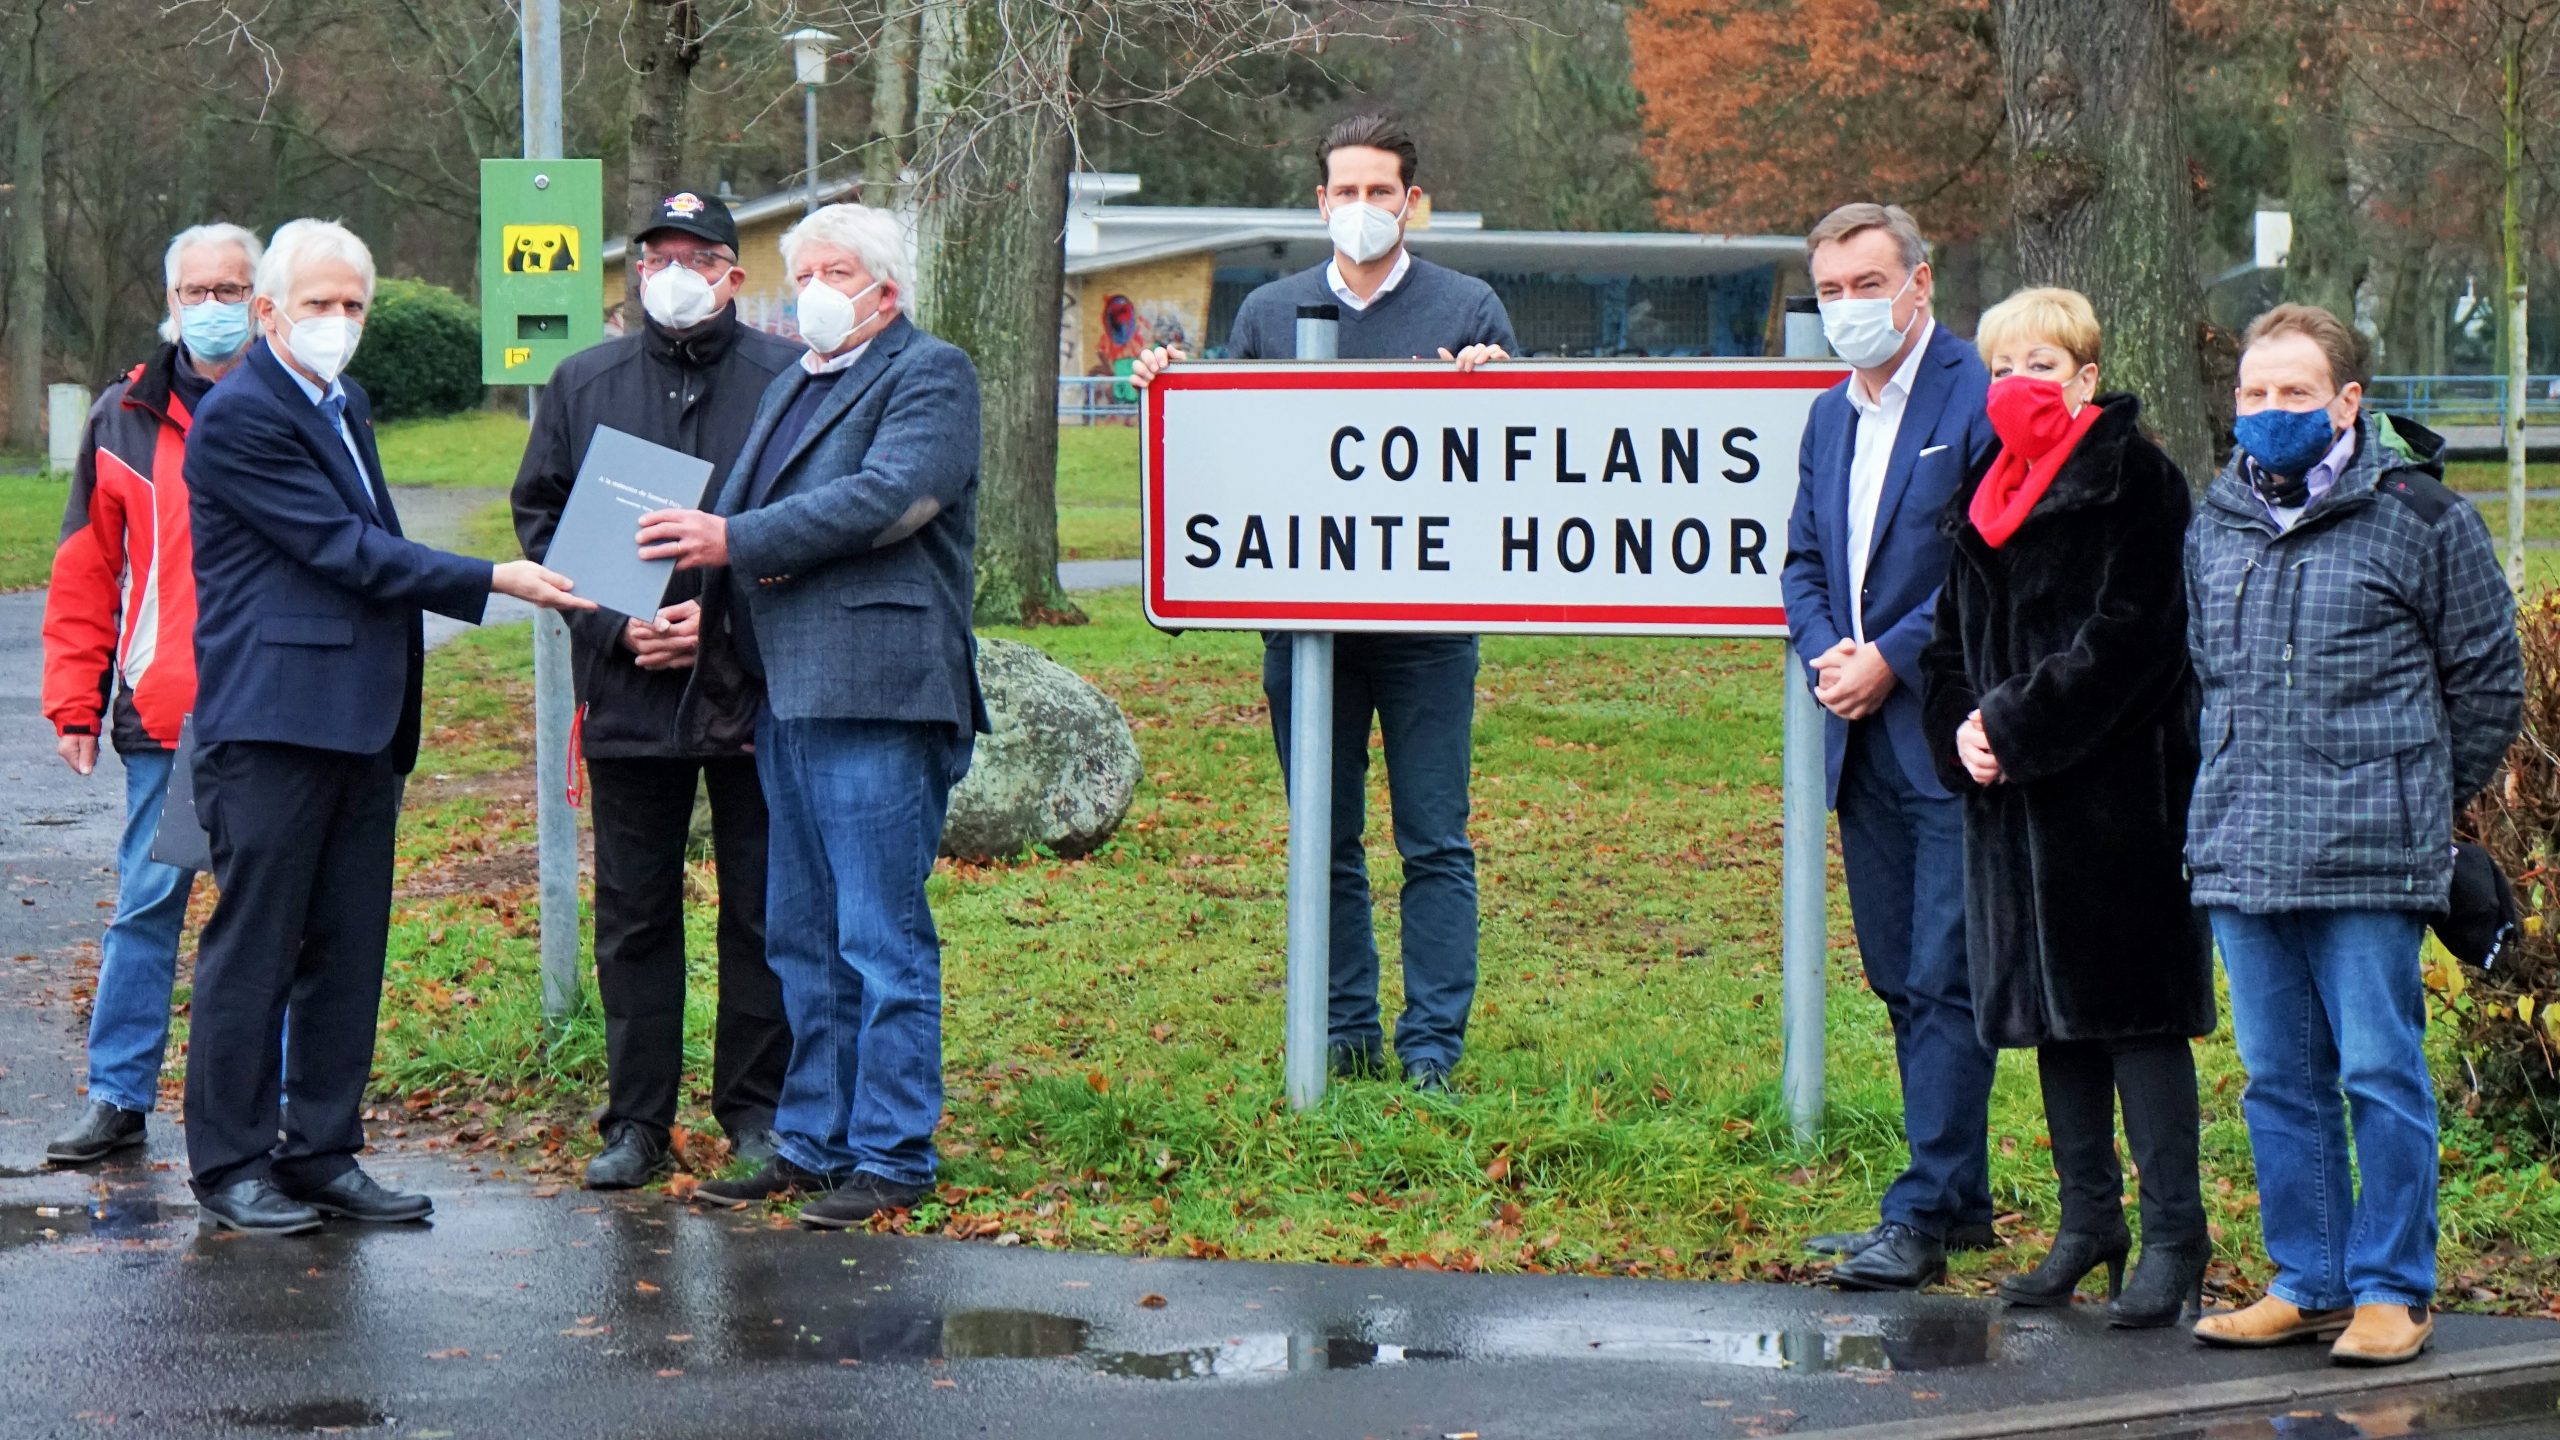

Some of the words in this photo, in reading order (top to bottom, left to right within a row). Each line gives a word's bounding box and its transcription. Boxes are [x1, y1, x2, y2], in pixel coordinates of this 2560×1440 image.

[1330, 425, 1761, 484] CONFLANS
[1185, 513, 1451, 571] SAINTE
[1501, 516, 1790, 575] HONOR
